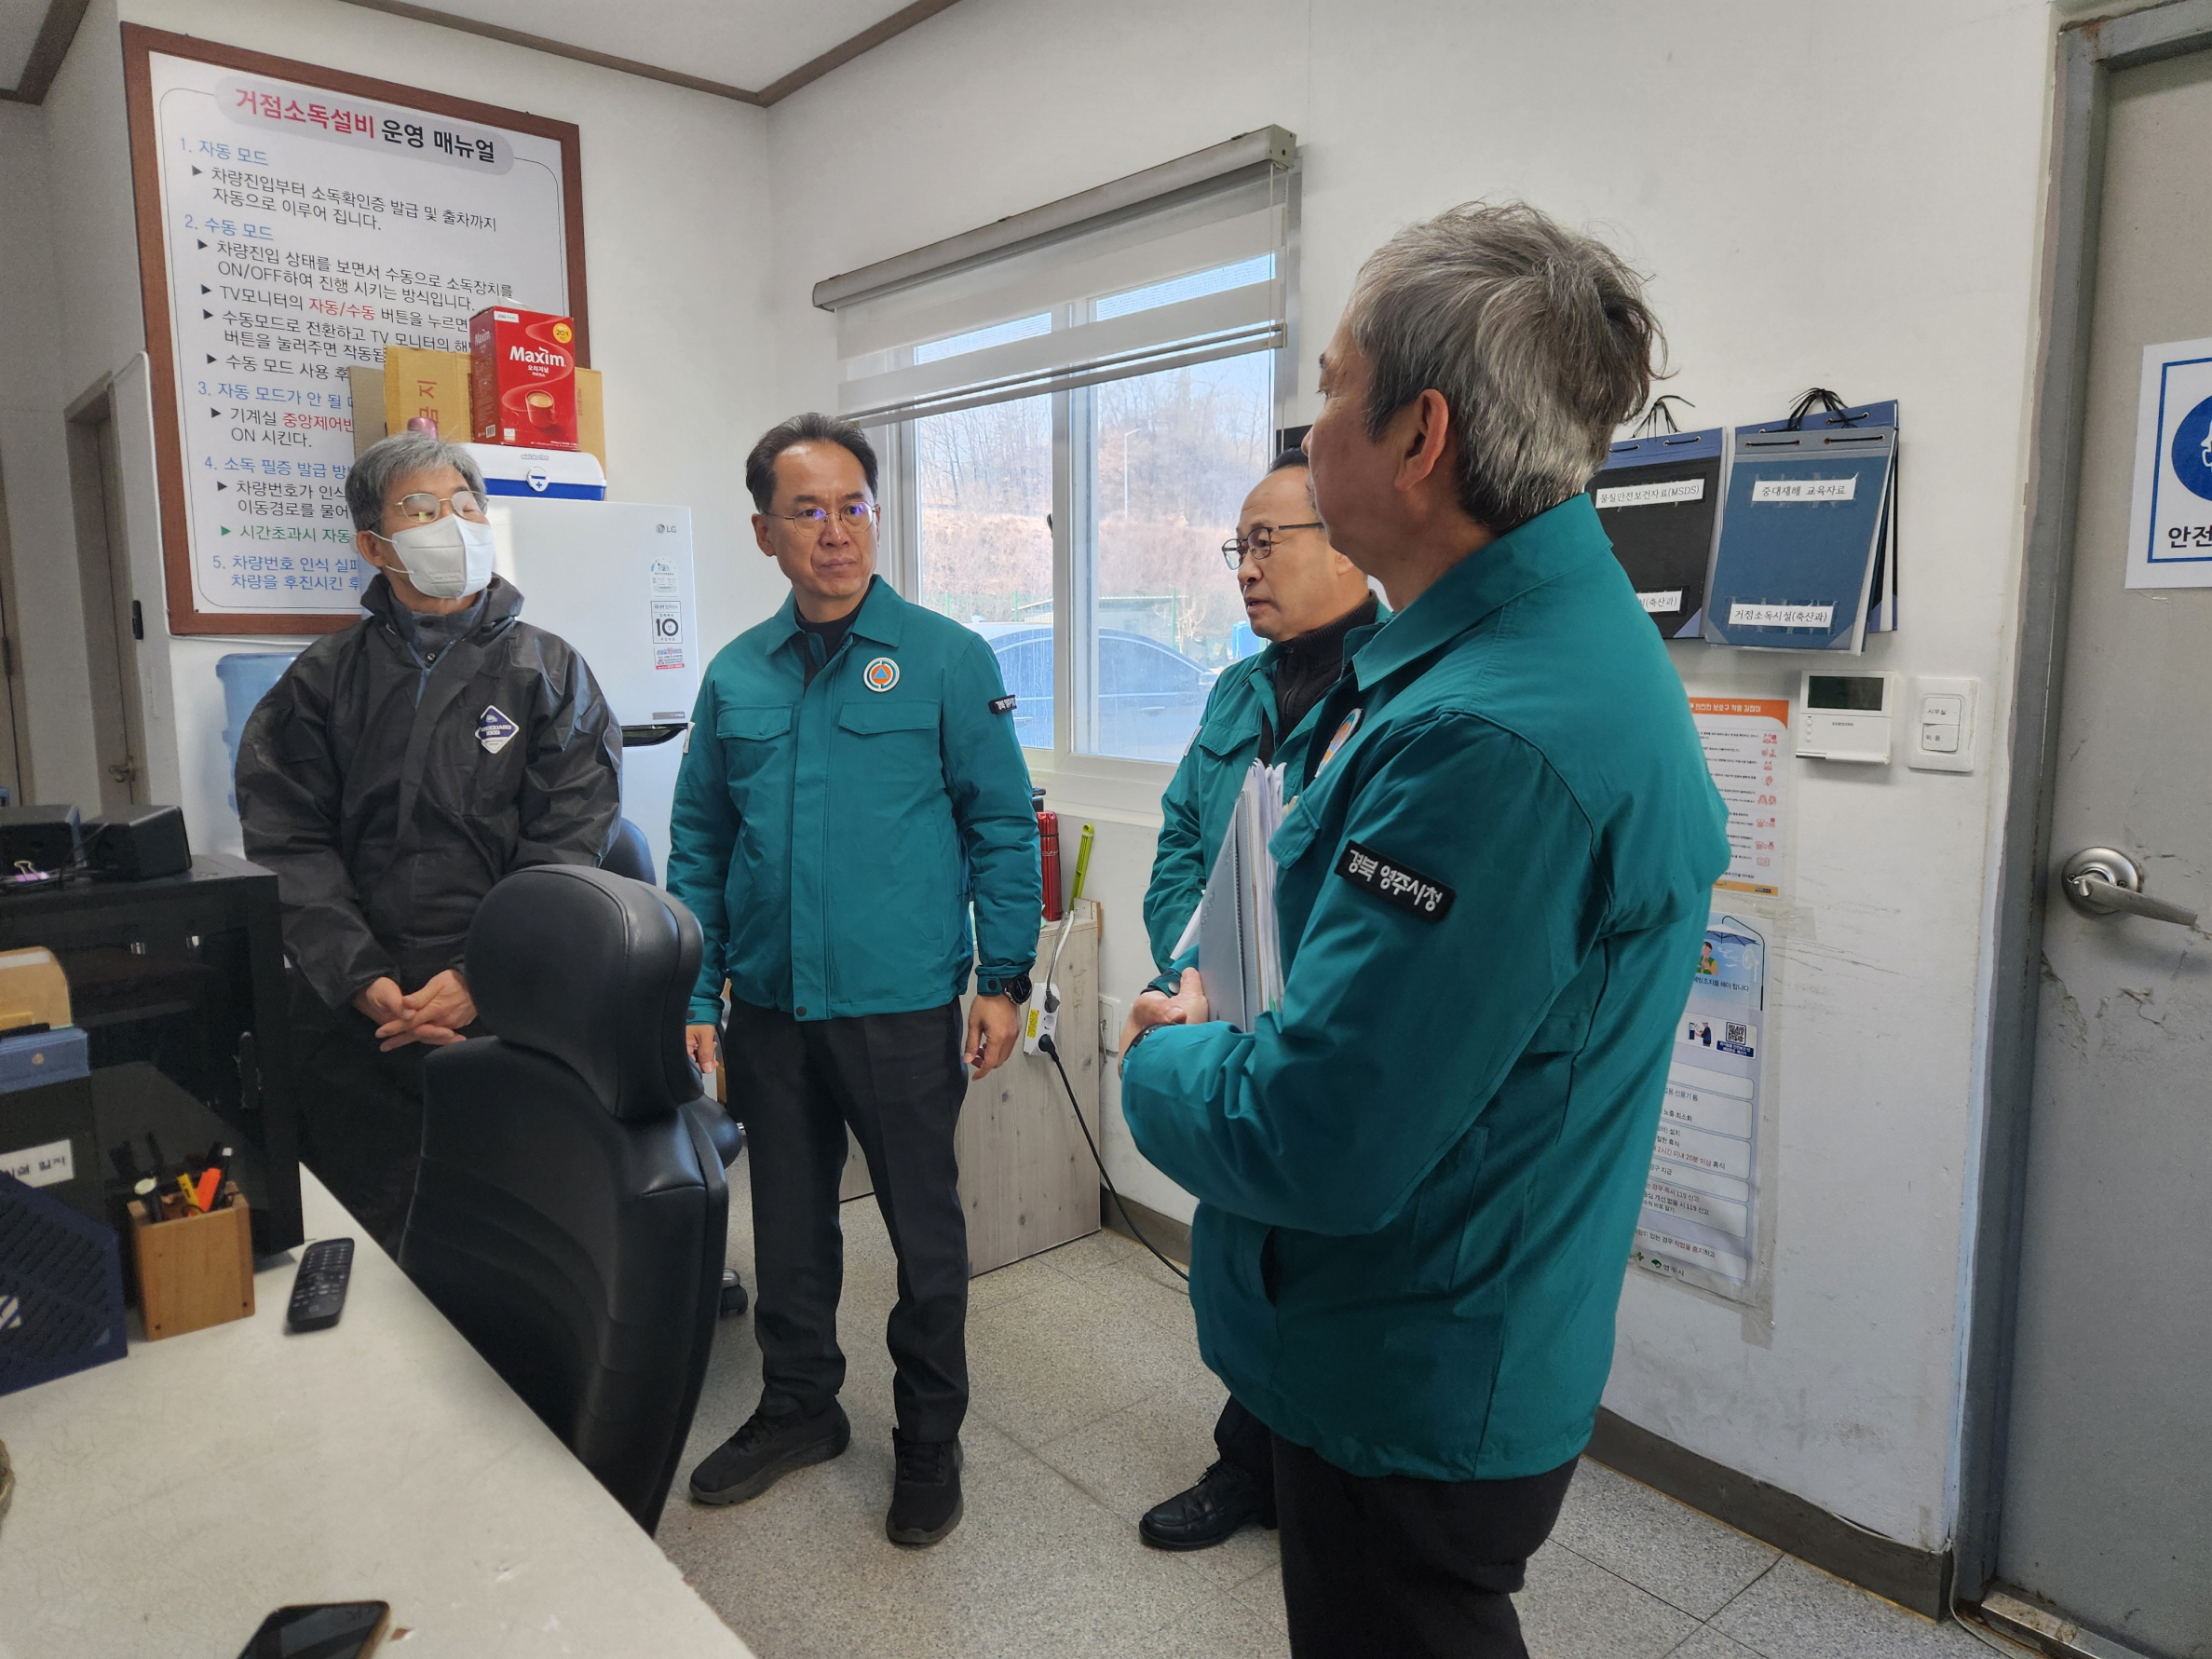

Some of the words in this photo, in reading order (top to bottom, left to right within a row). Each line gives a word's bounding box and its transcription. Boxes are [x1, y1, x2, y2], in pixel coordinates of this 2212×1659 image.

[236, 88, 374, 139] 거점소독설비
[382, 119, 424, 148] 운영
[434, 130, 495, 163] 매뉴얼
[180, 137, 192, 153] 1.
[199, 140, 231, 160] 자동
[237, 147, 268, 166] 모드
[211, 167, 305, 198] 차량진입부터
[311, 186, 385, 212] 소독확인증
[390, 199, 418, 219] 발급
[424, 206, 437, 222] 및
[441, 210, 496, 232] 출차까지
[212, 187, 277, 211] 자동으로
[282, 200, 327, 222] 이루어
[332, 208, 382, 231] 집니다.
[184, 213, 197, 229] 2.
[204, 217, 236, 236] 수동
[242, 224, 274, 240] 모드
[217, 240, 279, 265] 차량진입
[285, 252, 331, 272] 상태를
[336, 259, 380, 279] 보면서
[385, 267, 441, 288] 수동으로
[446, 278, 513, 298] 소독장치를
[218, 261, 313, 289] ON/OFF하여
[319, 275, 348, 294] 진행
[354, 281, 397, 301] 시키는
[402, 288, 475, 311] 방식입니다.
[219, 285, 304, 311] TV모니터의
[308, 297, 375, 320] 자동/수동
[381, 307, 423, 327] 버튼을
[427, 314, 468, 333] 누르면
[222, 310, 302, 333] 수동모드로
[306, 321, 366, 342] 전환하고
[370, 330, 388, 344] TV
[395, 333, 450, 352] 모니터의
[455, 340, 471, 353] 해
[224, 330, 271, 349] 버튼을
[277, 336, 337, 358] 눌러주면
[225, 354, 257, 373] 수동
[263, 359, 294, 374] 모드
[299, 362, 329, 380] 사용
[509, 346, 565, 367] Maxim
[198, 382, 211, 396] 3.
[218, 382, 250, 401] 자동
[255, 387, 302, 405] 모드가
[306, 391, 322, 407] 안
[328, 394, 342, 410] 될
[231, 407, 277, 426] 기계실
[231, 428, 255, 442] ON
[261, 430, 312, 447] 시킨다.
[204, 456, 217, 470] 4.
[224, 456, 255, 473] 소독
[261, 458, 292, 476] 필증
[297, 461, 327, 478] 발급
[236, 481, 314, 499] 차량번호가
[1600, 484, 1700, 503] 물질안전보건자료(MSDS)
[1761, 485, 1801, 496] 중대재해
[1805, 484, 1846, 496] 교육자료
[237, 499, 315, 518] 이동경로를
[319, 504, 349, 519] 물어
[239, 524, 317, 542] 시간초과시
[322, 528, 350, 544] 자동
[666, 525, 677, 534] LG
[212, 555, 225, 569] 5.
[232, 555, 295, 571] 차량번호
[300, 557, 329, 573] 인식
[231, 574, 278, 590] 차량을
[283, 575, 343, 591] 후진시킨
[1734, 609, 1827, 623] 거점소독시설(축산과)
[656, 618, 679, 637] 10
[1349, 849, 1378, 882] 경북
[1379, 864, 1444, 912] 영주시청
[1732, 983, 1750, 992] 합니다
[1687, 1203, 1697, 1212] 119
